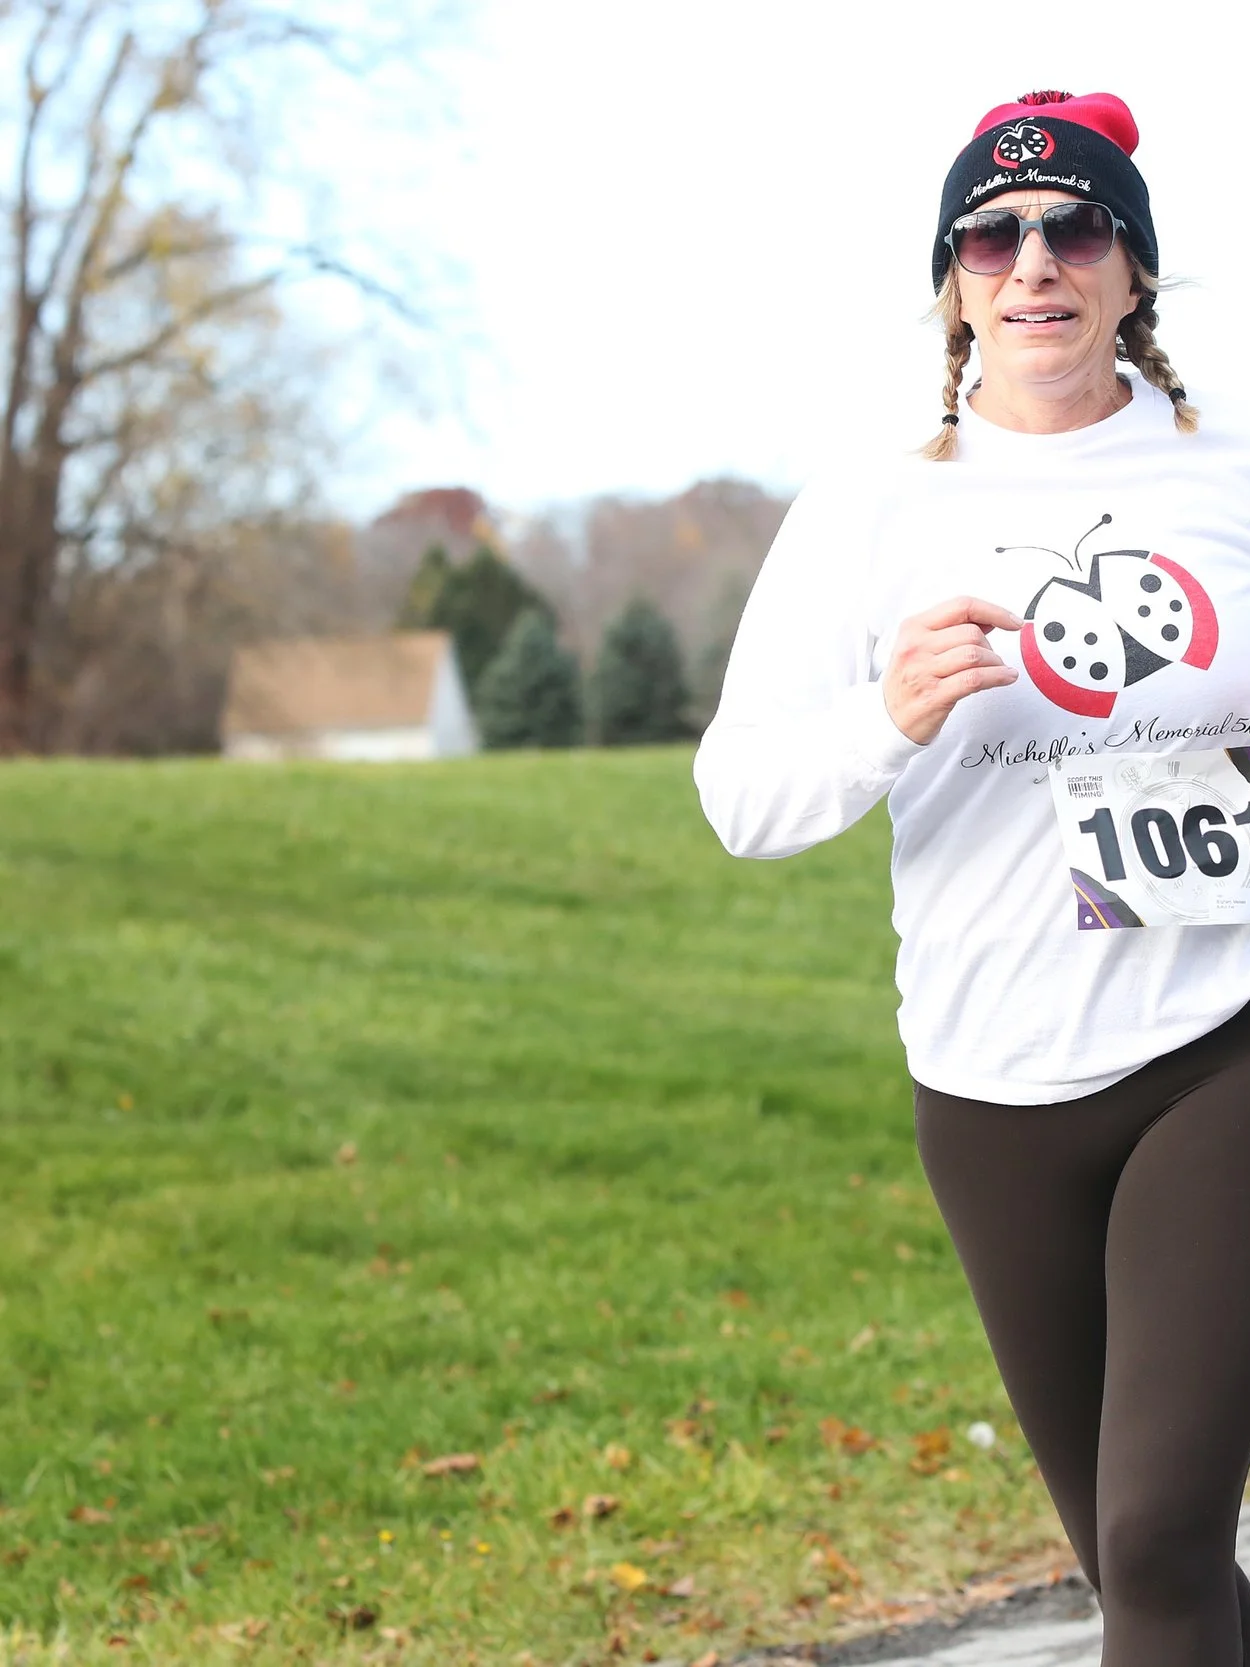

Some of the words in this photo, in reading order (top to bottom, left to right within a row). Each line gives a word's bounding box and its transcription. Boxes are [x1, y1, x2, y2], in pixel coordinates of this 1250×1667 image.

[965, 171, 1013, 204] Michelle's
[1015, 167, 1076, 187] Memorial
[960, 730, 1095, 769] Michelle's
[1104, 711, 1233, 748] Memorial
[1073, 790, 1103, 799] TIMING
